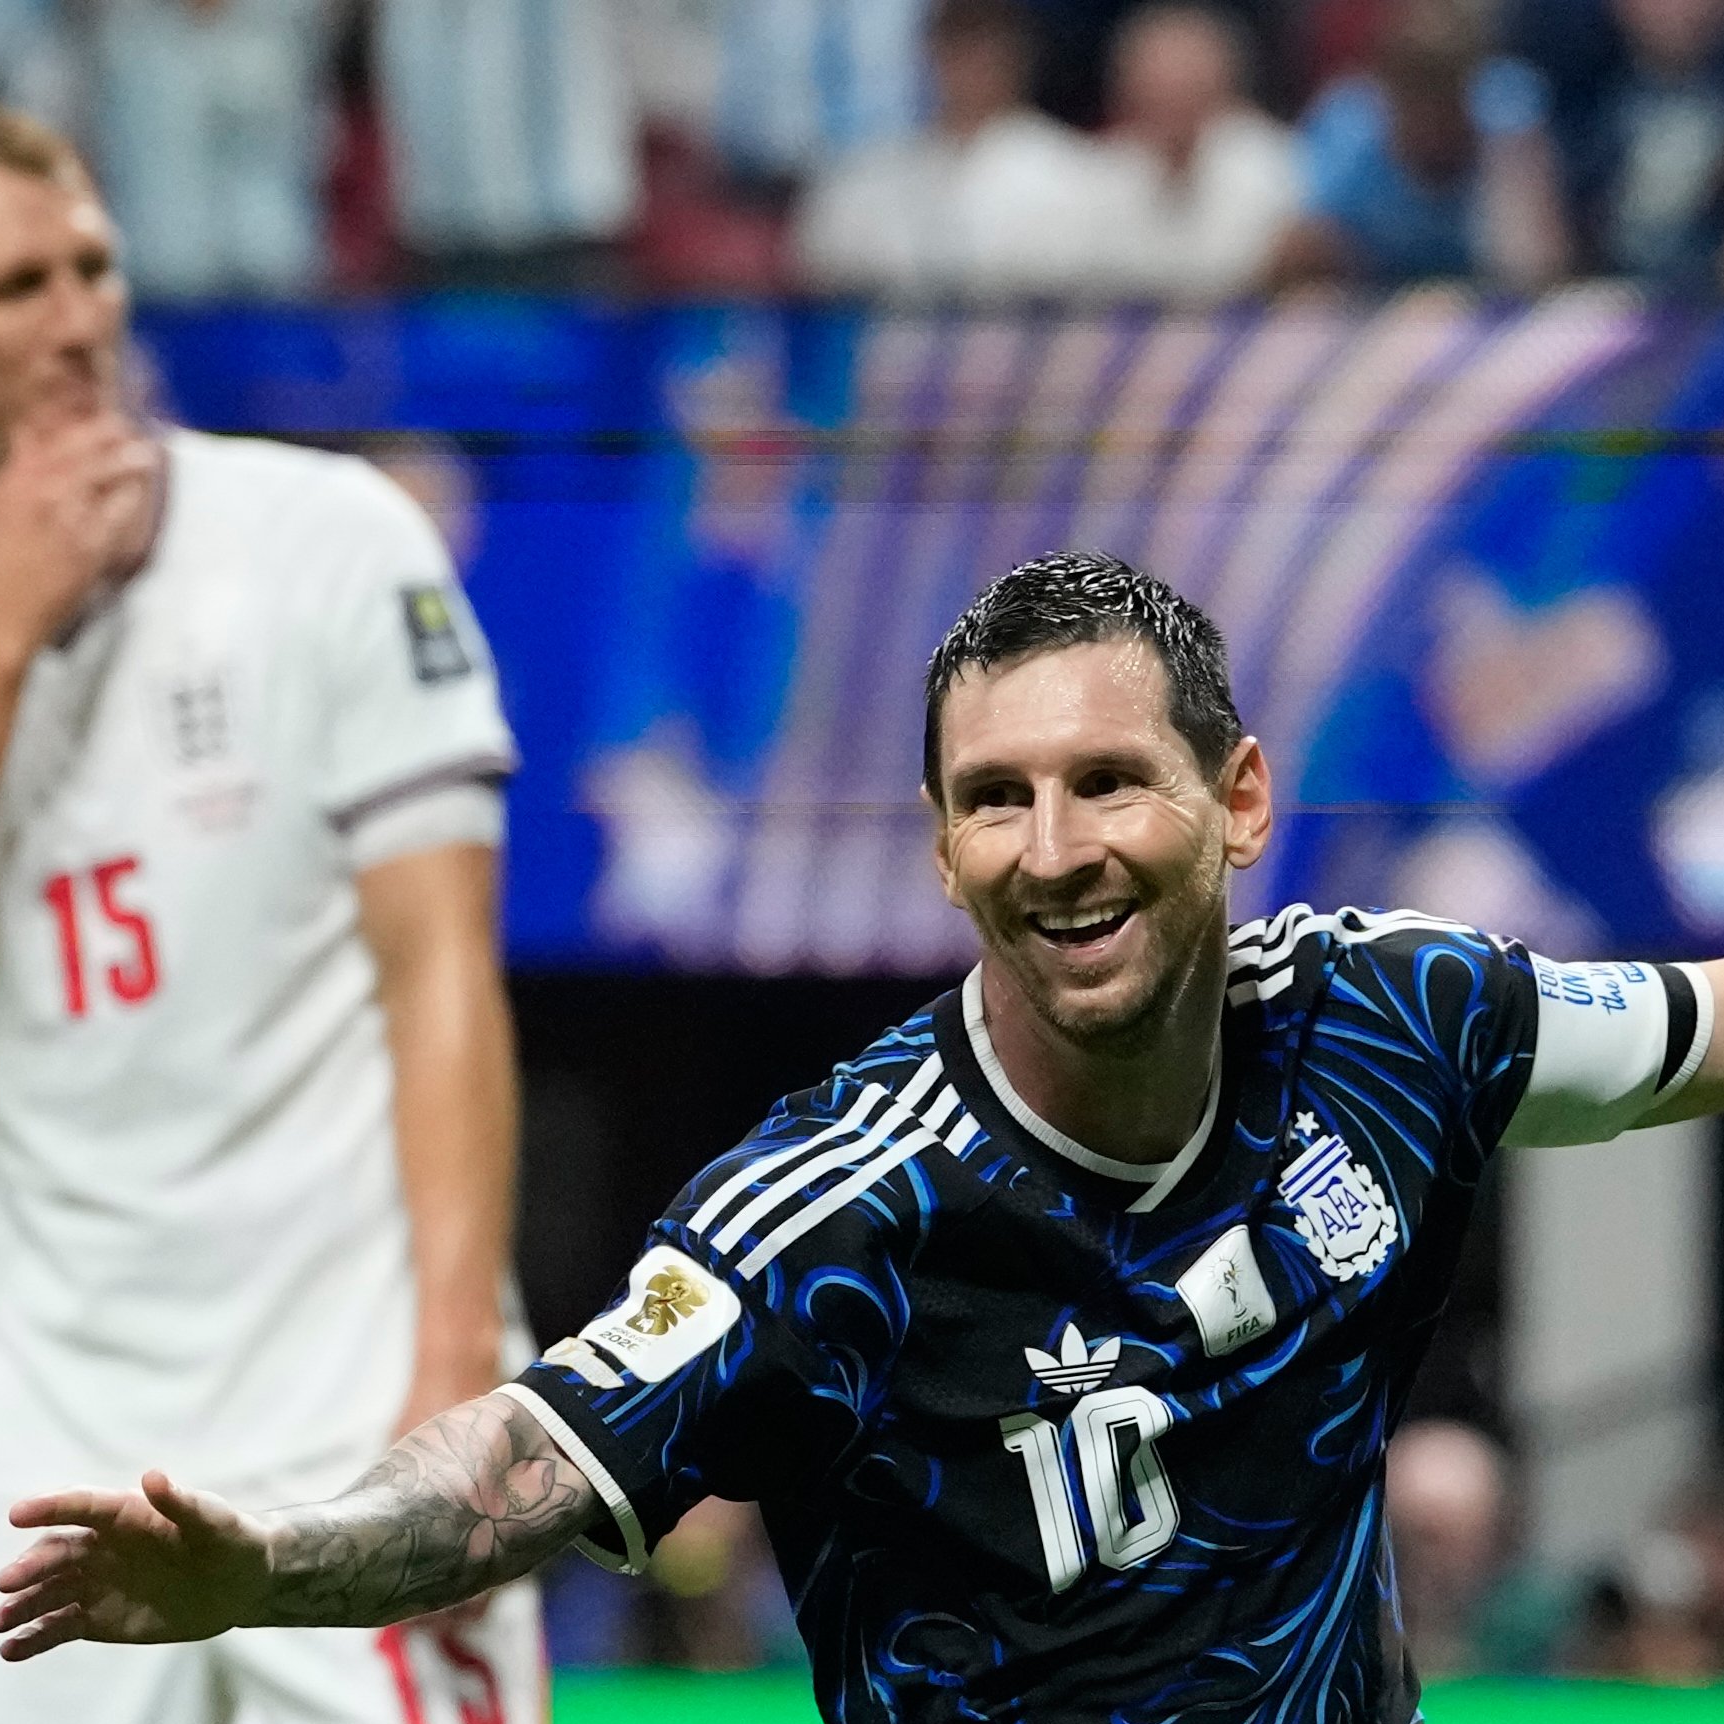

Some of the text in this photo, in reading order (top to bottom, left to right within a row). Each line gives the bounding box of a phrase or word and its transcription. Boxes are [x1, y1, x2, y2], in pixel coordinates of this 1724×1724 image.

[43, 857, 157, 1015] 15
[1536, 962, 1560, 1000] FOO
[1311, 1175, 1368, 1241] AFA
[1227, 1315, 1260, 1343] FIFA
[998, 1385, 1181, 1595] 10
